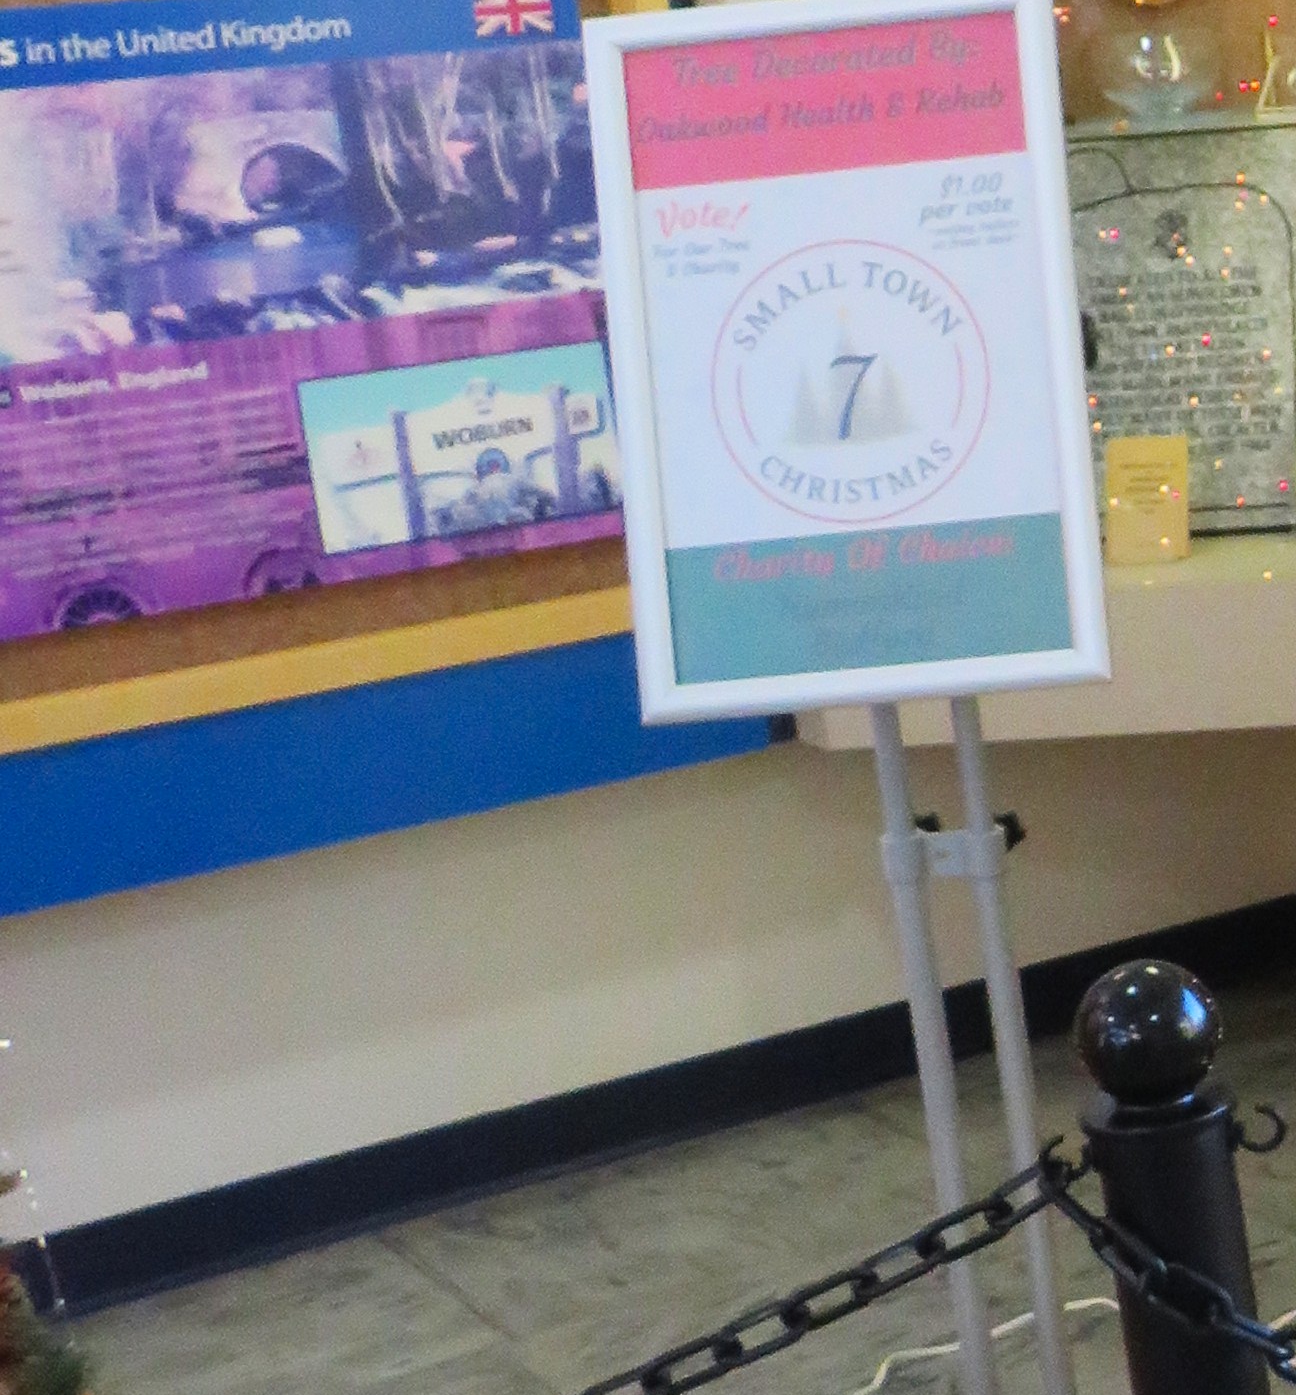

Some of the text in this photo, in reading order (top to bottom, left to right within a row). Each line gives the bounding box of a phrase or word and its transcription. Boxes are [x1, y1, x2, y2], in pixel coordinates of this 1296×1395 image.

[25, 37, 56, 65] in
[59, 31, 112, 63] the
[114, 19, 216, 58] United
[219, 16, 352, 53] Kingdom
[671, 55, 738, 87] Tree
[752, 28, 916, 80] Decorated
[635, 102, 772, 144] Oakwood
[780, 91, 874, 129] Health
[914, 77, 1006, 115] Rehab
[940, 171, 1003, 200] $1.00
[654, 200, 750, 239] Vote!
[918, 196, 1013, 227] per vote
[733, 260, 965, 352] SMALL TOWN
[829, 352, 879, 441] 7
[432, 416, 534, 451] WOBURN
[759, 437, 954, 505] CHRISTMAS
[713, 542, 836, 584] Charity
